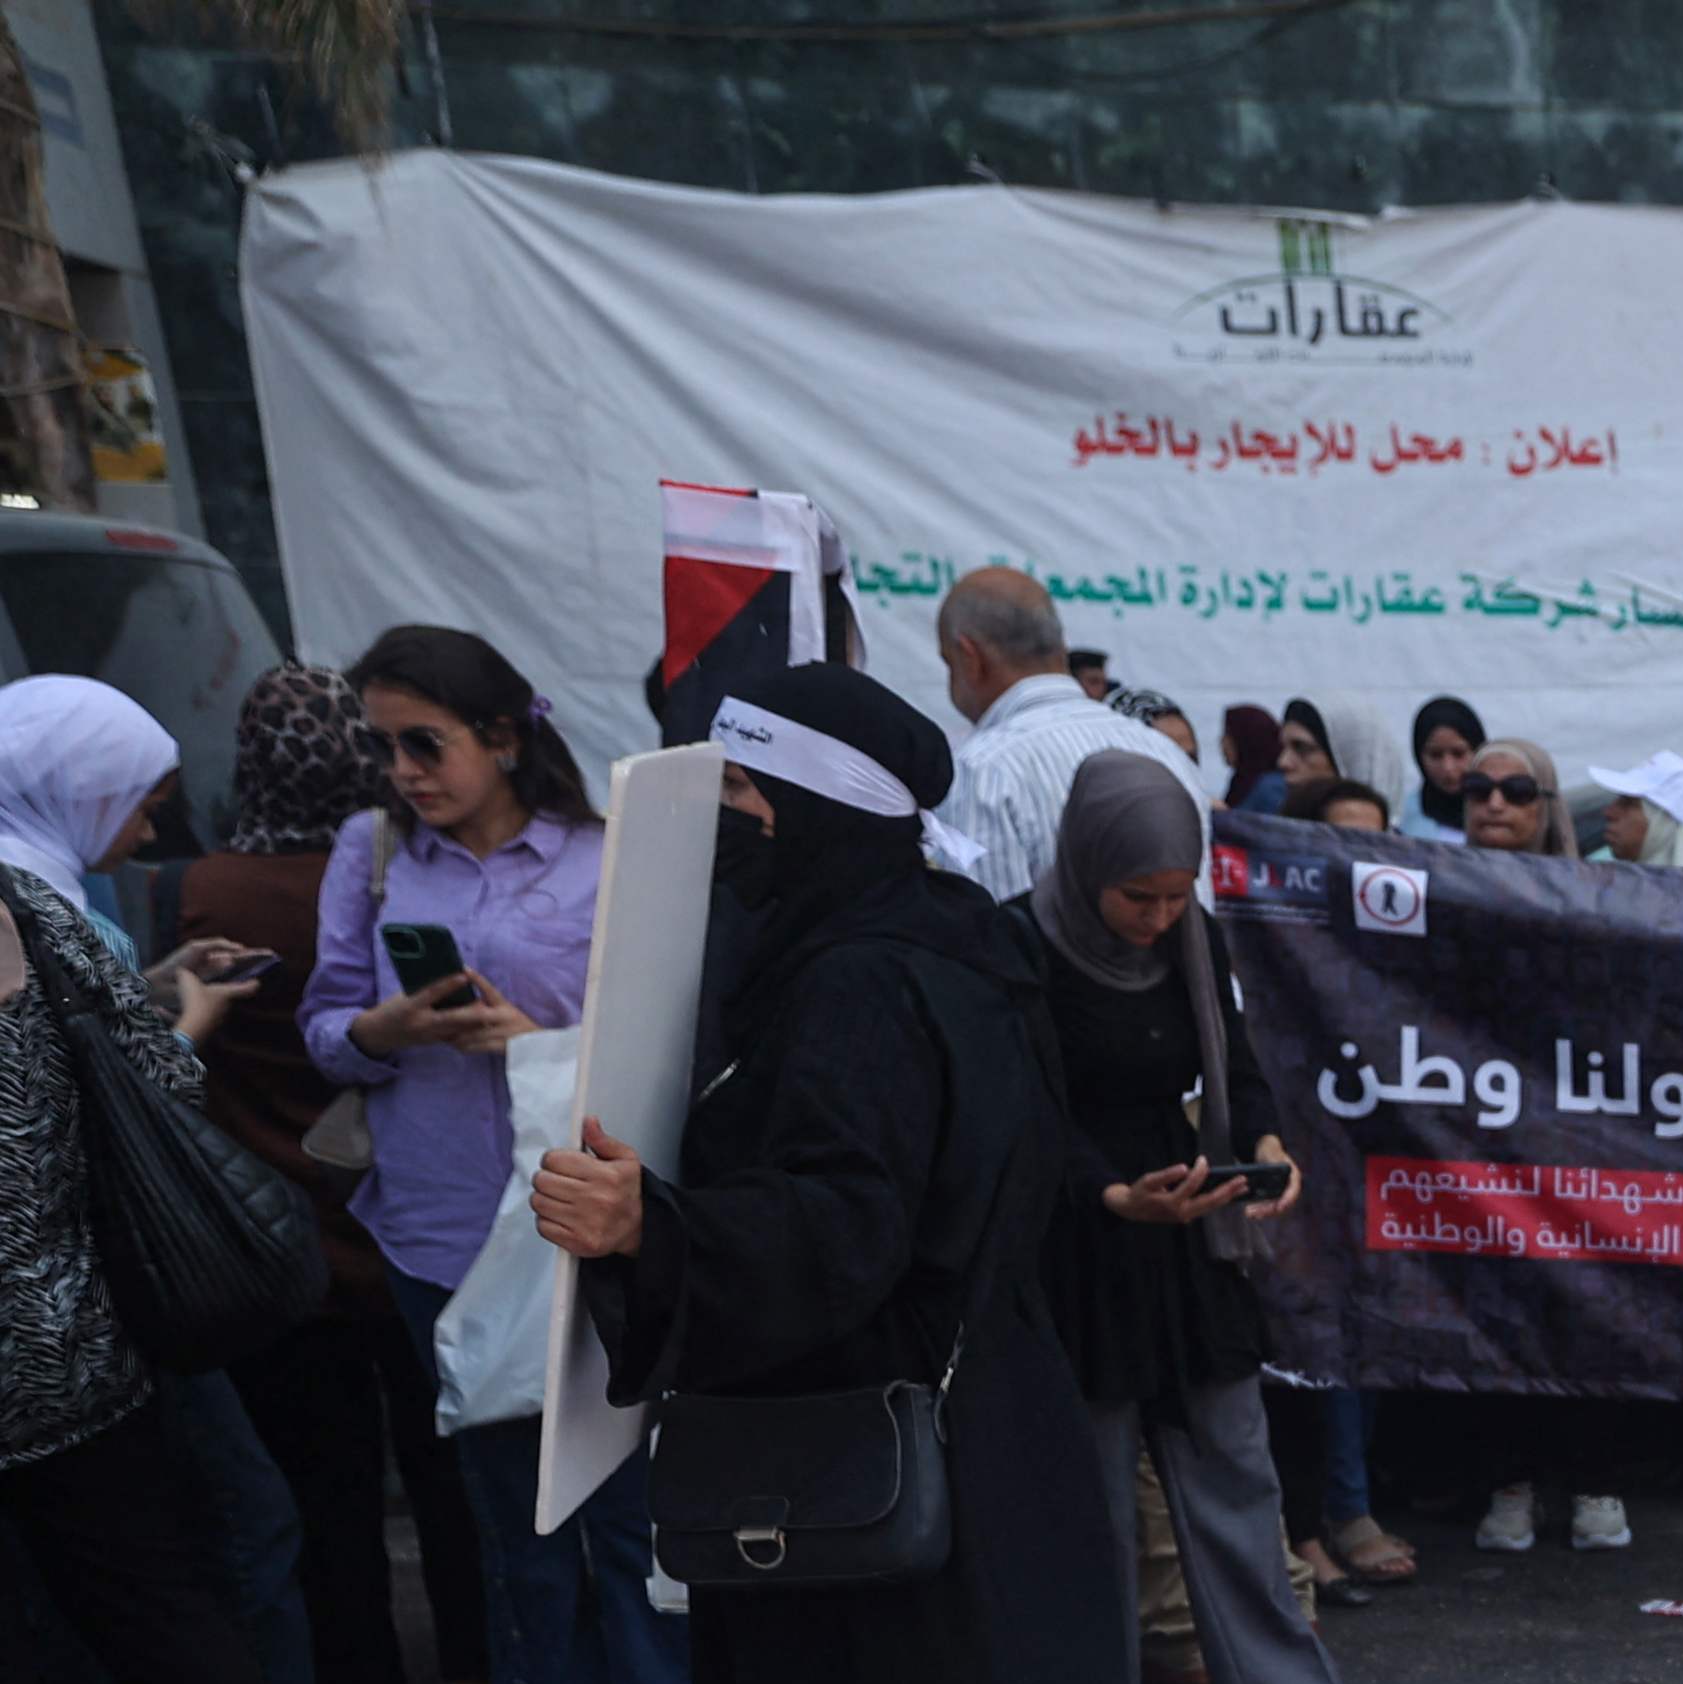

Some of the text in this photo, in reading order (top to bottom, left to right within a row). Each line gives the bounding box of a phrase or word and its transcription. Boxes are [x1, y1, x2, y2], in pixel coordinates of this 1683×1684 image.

[1219, 277, 1421, 346] عقارات
[1069, 412, 1199, 475] بالخلو
[1370, 420, 1463, 475] محل
[1300, 571, 1444, 626] عقارات
[1460, 572, 1598, 630] شركة
[1316, 1024, 1523, 1130] وطن
[1380, 1163, 1541, 1203] لنشيعهم
[1380, 1212, 1528, 1255] والوطنية
[1534, 1219, 1680, 1264] الإنسانية
